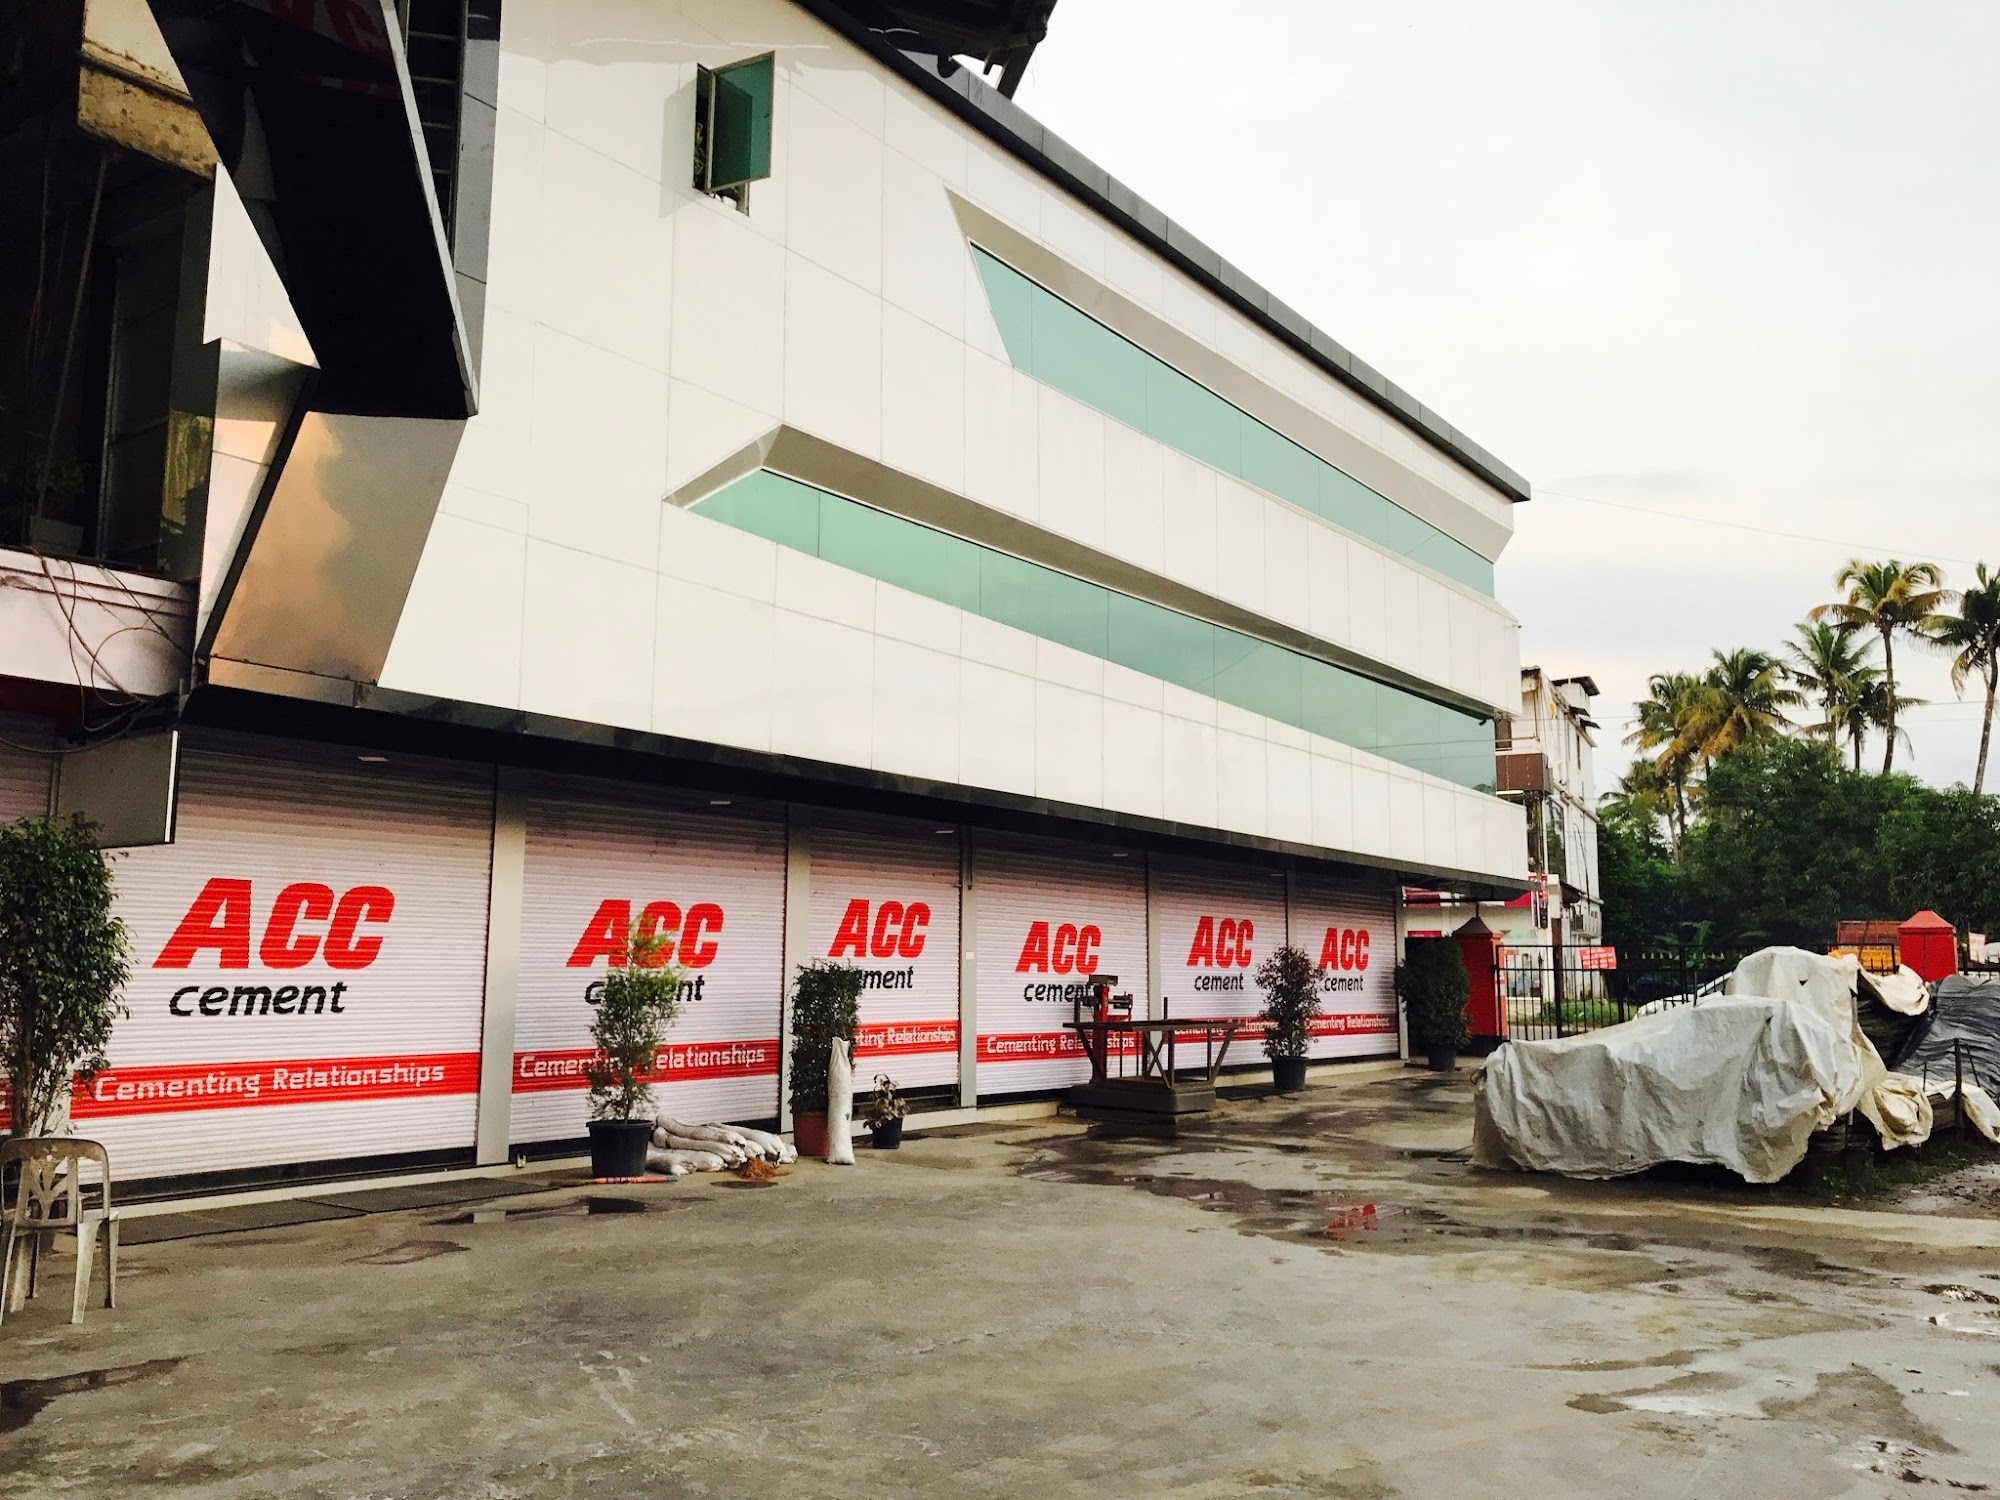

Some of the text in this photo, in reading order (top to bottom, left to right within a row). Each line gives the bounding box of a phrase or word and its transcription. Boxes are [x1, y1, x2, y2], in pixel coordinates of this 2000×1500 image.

[151, 878, 395, 969] ACC
[566, 899, 724, 968] ACC
[828, 899, 931, 958] ACC
[1015, 921, 1102, 975] ACC
[1186, 916, 1254, 969] ACC
[1319, 927, 1370, 971] ACC
[584, 975, 705, 1005] cnt
[862, 966, 914, 989] ment
[1194, 973, 1244, 991] cement
[1324, 976, 1364, 992] cement
[169, 982, 348, 1016] cement
[887, 1026, 956, 1044] Relationships
[986, 1035, 1056, 1054] Cementing
[656, 1045, 766, 1070] elationships
[95, 1062, 445, 1102] Cementing Relationships
